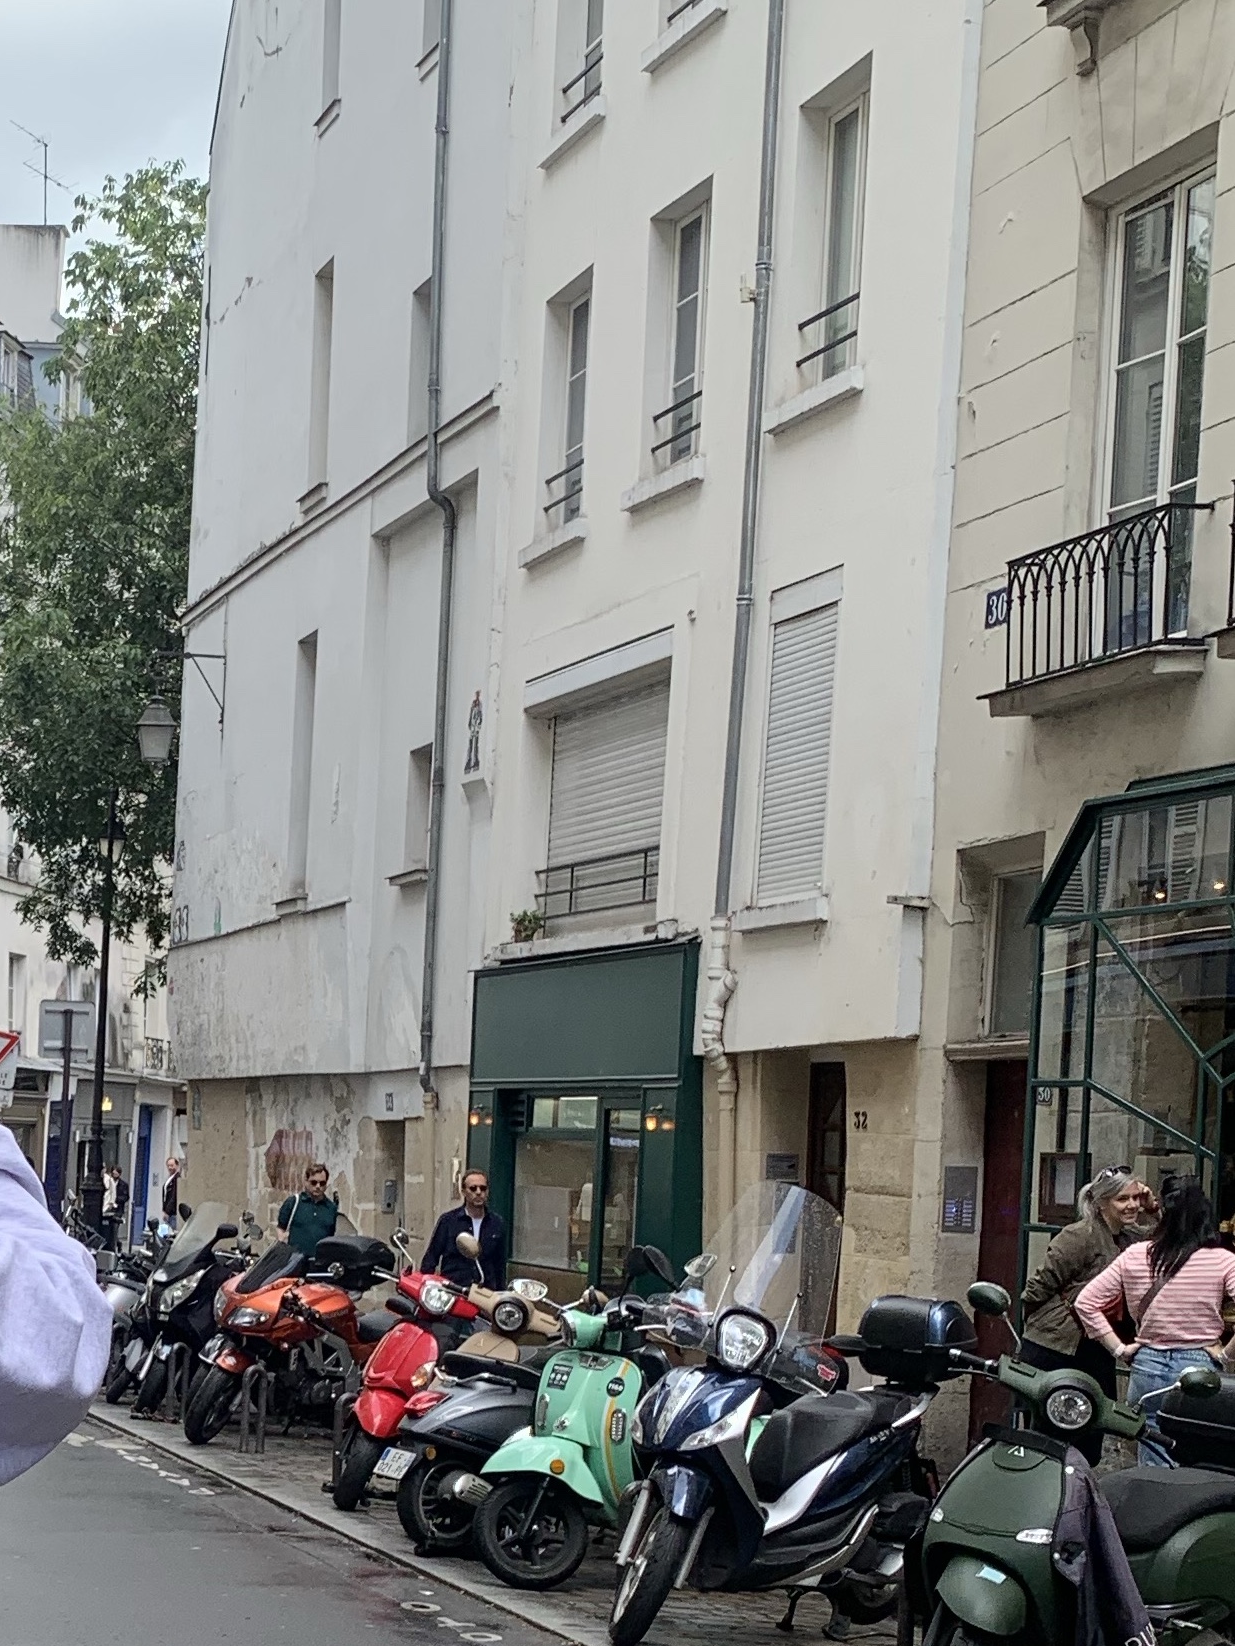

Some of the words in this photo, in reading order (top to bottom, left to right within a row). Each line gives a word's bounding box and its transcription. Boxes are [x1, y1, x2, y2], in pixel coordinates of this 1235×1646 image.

[988, 592, 1008, 624] 30
[1037, 1086, 1051, 1102] 30
[853, 1110, 868, 1130] 32
